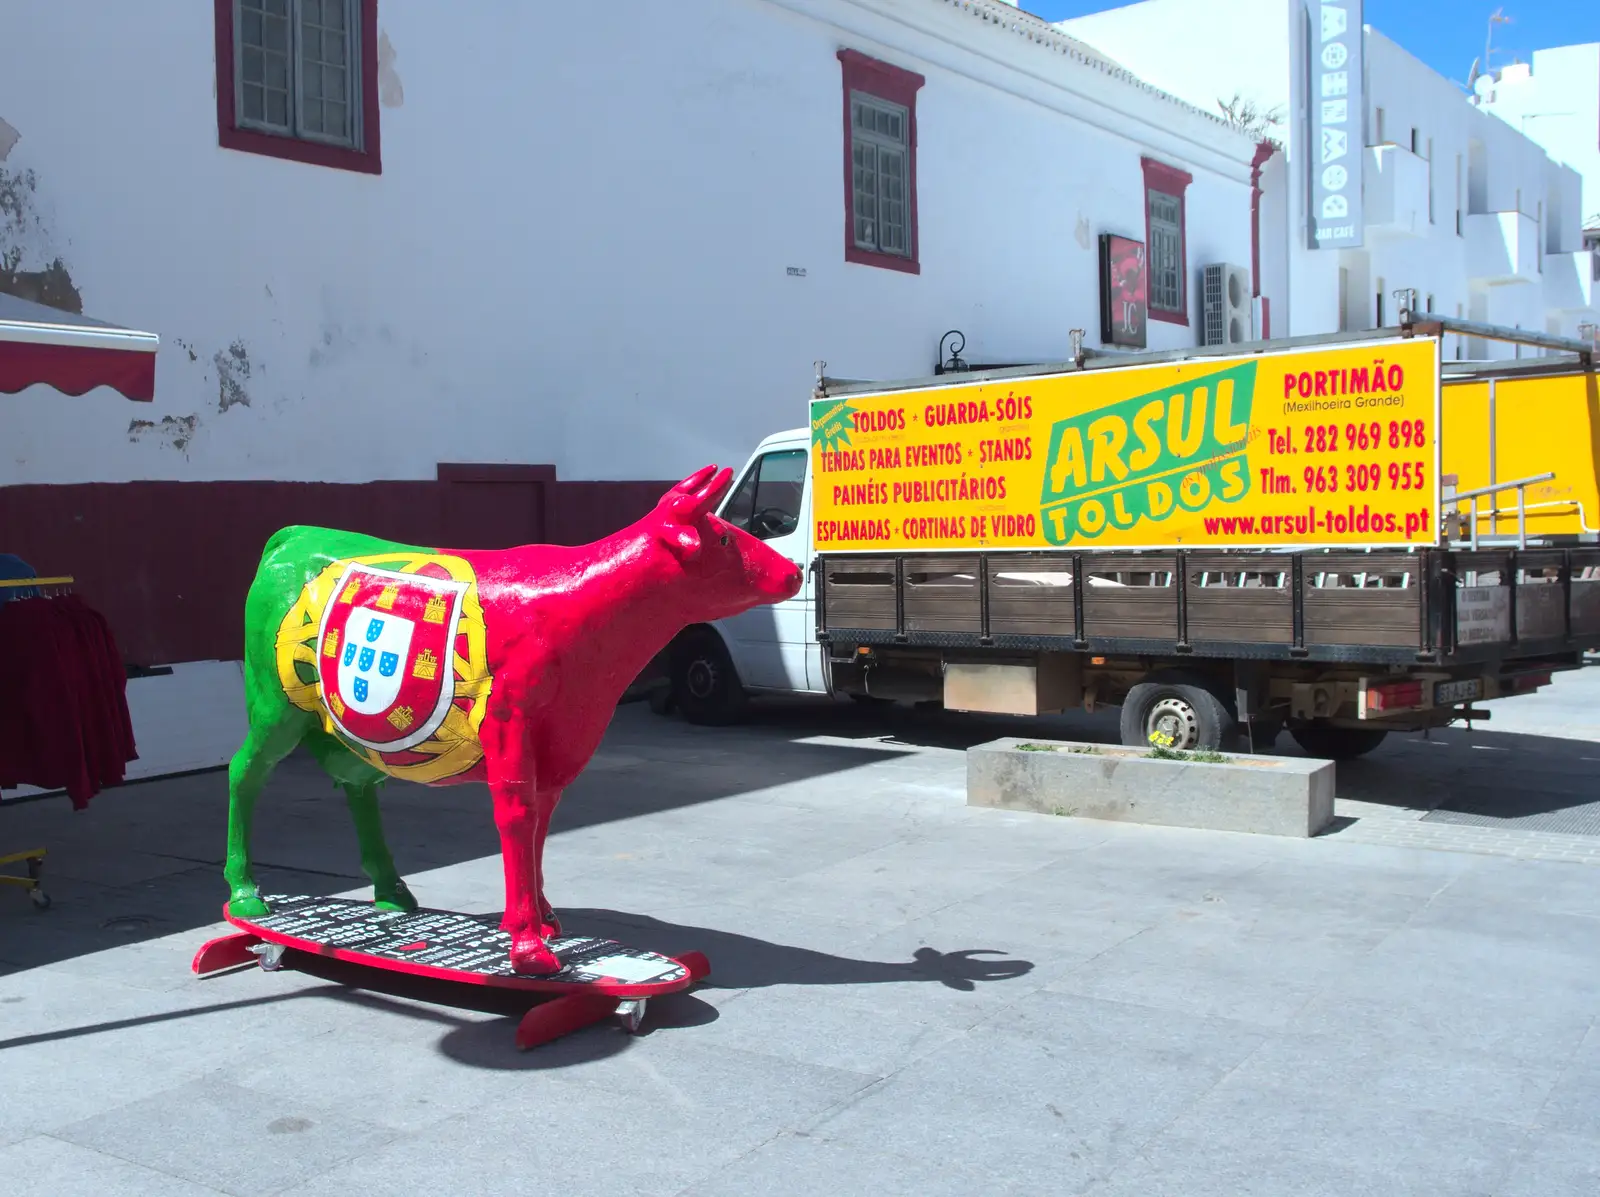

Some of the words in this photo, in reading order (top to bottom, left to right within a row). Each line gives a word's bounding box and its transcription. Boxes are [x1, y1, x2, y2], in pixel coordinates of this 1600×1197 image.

[1320, 0, 1348, 219] DOWNTOW
[1284, 359, 1403, 399] PORTIMÃO
[853, 408, 906, 433] TOLDOS
[925, 391, 1033, 428] GUARDA-SÓIS
[1283, 398, 1350, 415] (Mexilhoeira
[1355, 394, 1405, 409] Grande)
[1051, 379, 1247, 493] ARSUL
[1268, 426, 1297, 455] Tel.
[1304, 424, 1338, 454] 282
[1346, 422, 1381, 451] 969
[1389, 419, 1425, 449] 898
[821, 448, 865, 473] TENDAS
[869, 445, 901, 470] PARA
[906, 442, 962, 467] EVENTOS
[979, 437, 1032, 464] STANDS
[833, 477, 888, 506] PAINÉIS
[893, 472, 1006, 504] PUBLICITÁRIOS
[1260, 467, 1297, 494] Tlm.
[1304, 465, 1338, 493] 963
[1346, 463, 1381, 492] 309
[1388, 462, 1425, 491] 955
[1049, 460, 1244, 541] TOLDOS
[817, 518, 891, 542] ESPLANADAS
[903, 516, 966, 540] CORTINAS
[970, 516, 986, 538] DE
[991, 513, 1035, 538] VIDRO
[1204, 505, 1429, 539] www.arsul-toldos.pt
